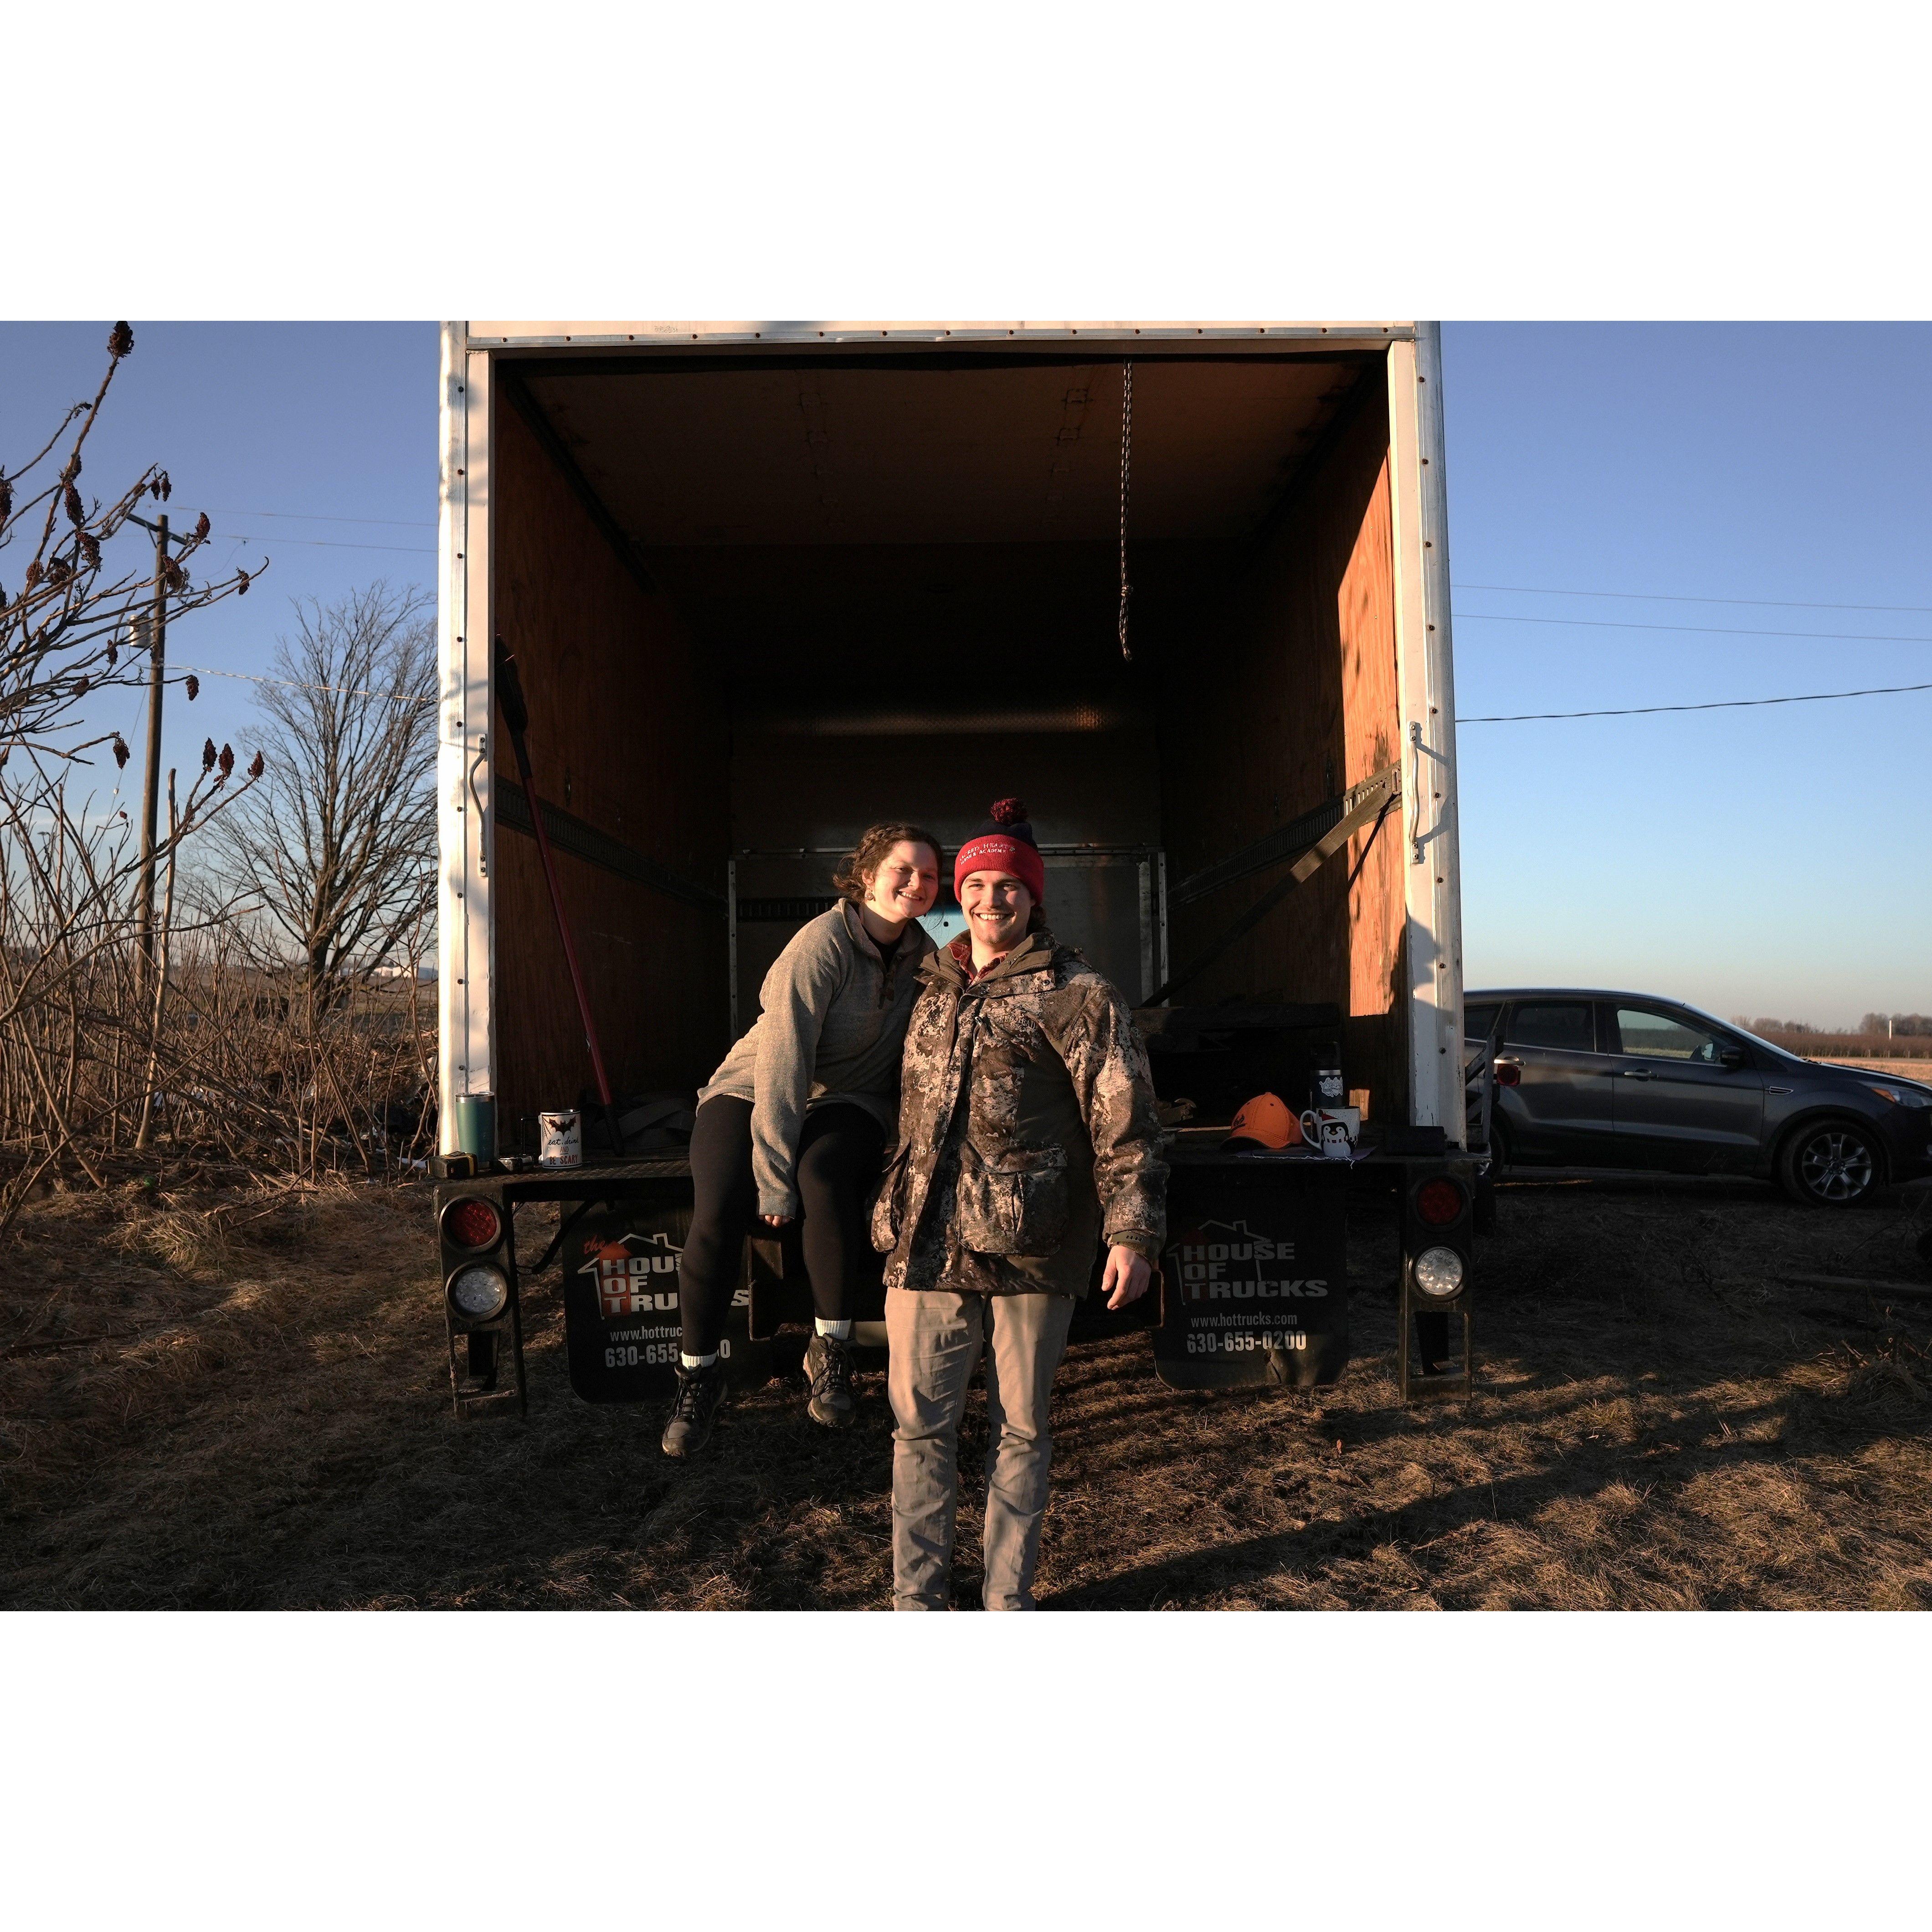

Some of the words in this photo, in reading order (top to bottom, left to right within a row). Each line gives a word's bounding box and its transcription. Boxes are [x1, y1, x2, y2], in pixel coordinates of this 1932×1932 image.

[564, 1136, 579, 1145] drink
[550, 1156, 556, 1165] BE
[560, 1153, 578, 1165] SCARY
[1184, 1242, 1295, 1262] HOUSE
[602, 1253, 683, 1276] HOU
[1184, 1262, 1227, 1280] OF
[603, 1275, 647, 1294] OF
[1185, 1279, 1329, 1299] TRUCKS
[604, 1289, 749, 1313] TRUS
[1191, 1311, 1298, 1328] www.hottrucks.com
[610, 1326, 683, 1341] www.hottruc
[1187, 1330, 1307, 1353] 630-655-0200
